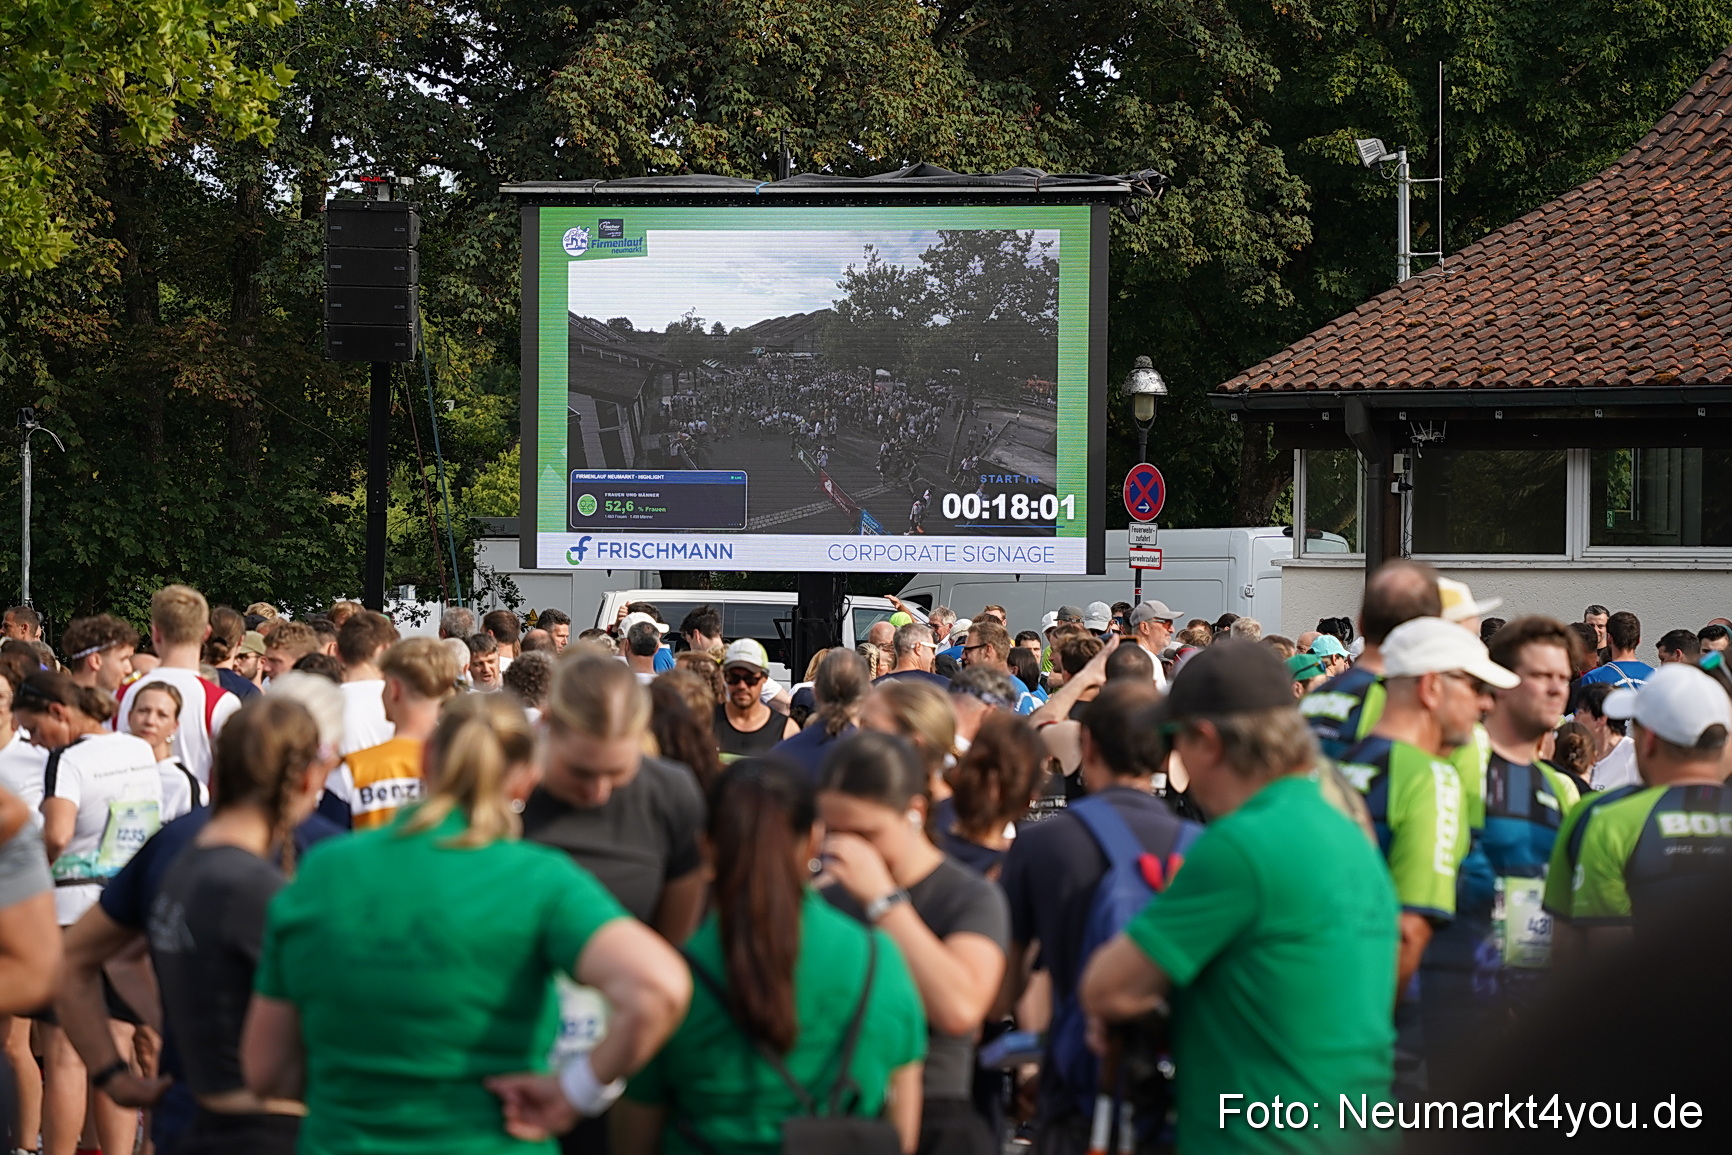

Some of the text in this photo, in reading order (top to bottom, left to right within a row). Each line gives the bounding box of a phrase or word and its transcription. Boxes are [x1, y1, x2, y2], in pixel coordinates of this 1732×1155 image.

[591, 237, 643, 249] Firmenlauf
[980, 474, 1039, 484] START IN
[604, 500, 635, 514] 52,6
[942, 493, 1076, 520] 00:18:01
[597, 541, 734, 560] FRISCHMANN
[827, 543, 1056, 564] CORPORATE SIGNAGE
